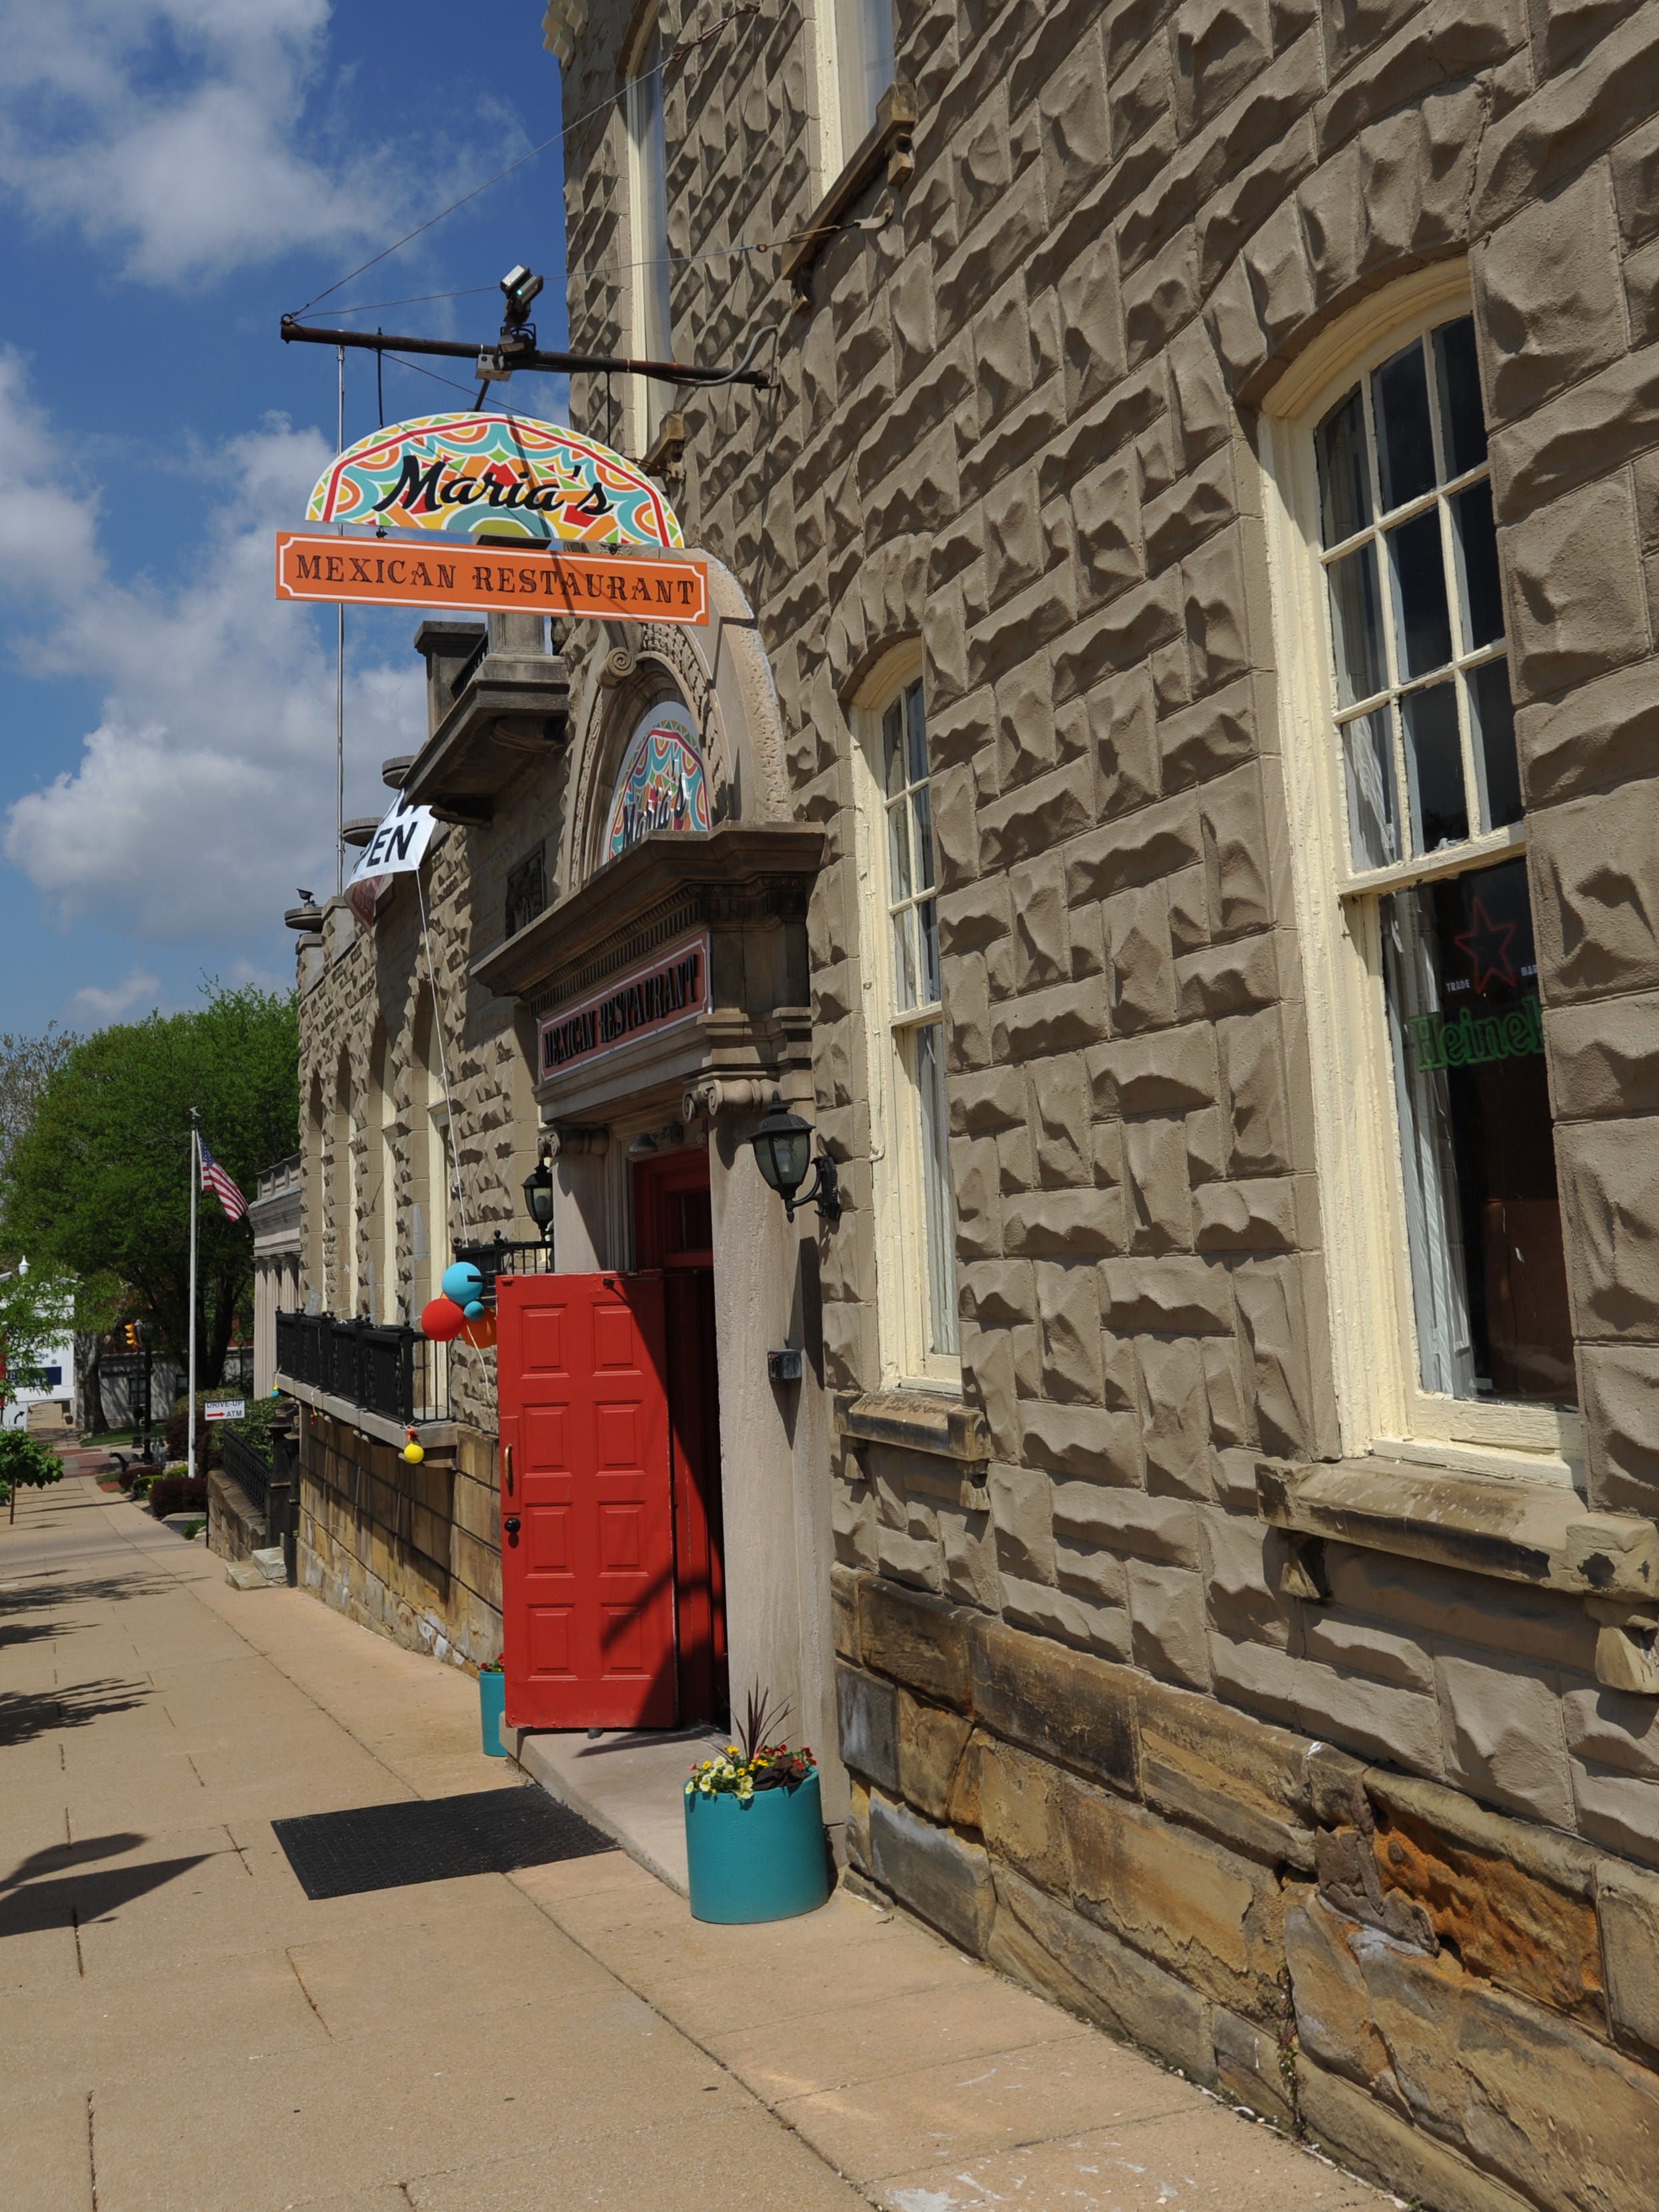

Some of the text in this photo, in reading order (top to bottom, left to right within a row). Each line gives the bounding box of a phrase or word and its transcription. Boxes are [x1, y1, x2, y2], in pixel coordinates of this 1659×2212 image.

[371, 455, 615, 515] Maria's
[295, 554, 695, 605] MEXICAN RESTAURANT
[1446, 979, 1471, 992] TRADE
[543, 954, 697, 1068] MEXICAN RESTAURANT
[207, 1400, 243, 1408] DRIVE-UP
[226, 1410, 242, 1418] ATM
